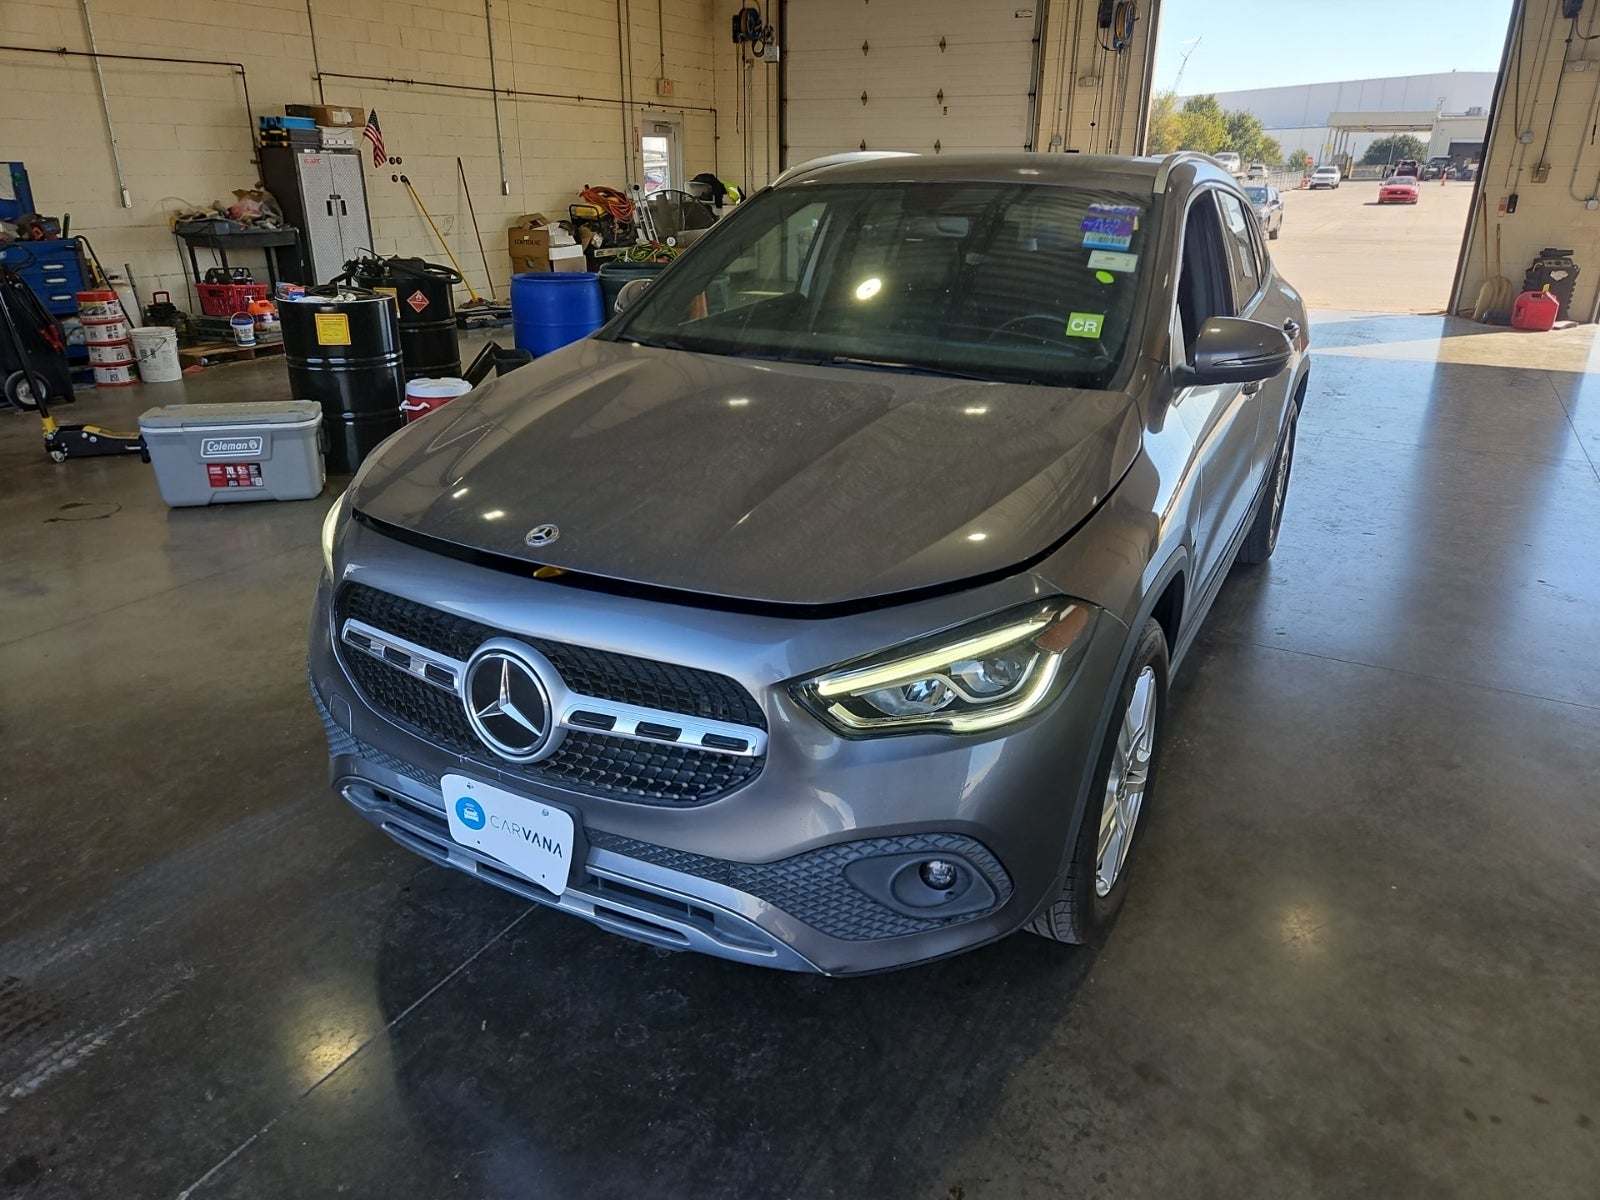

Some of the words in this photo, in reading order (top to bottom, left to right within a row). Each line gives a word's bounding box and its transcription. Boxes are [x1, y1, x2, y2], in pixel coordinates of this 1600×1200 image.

[1071, 318, 1098, 333] CR
[207, 441, 248, 451] Coleman
[490, 815, 562, 858] CARVANA
